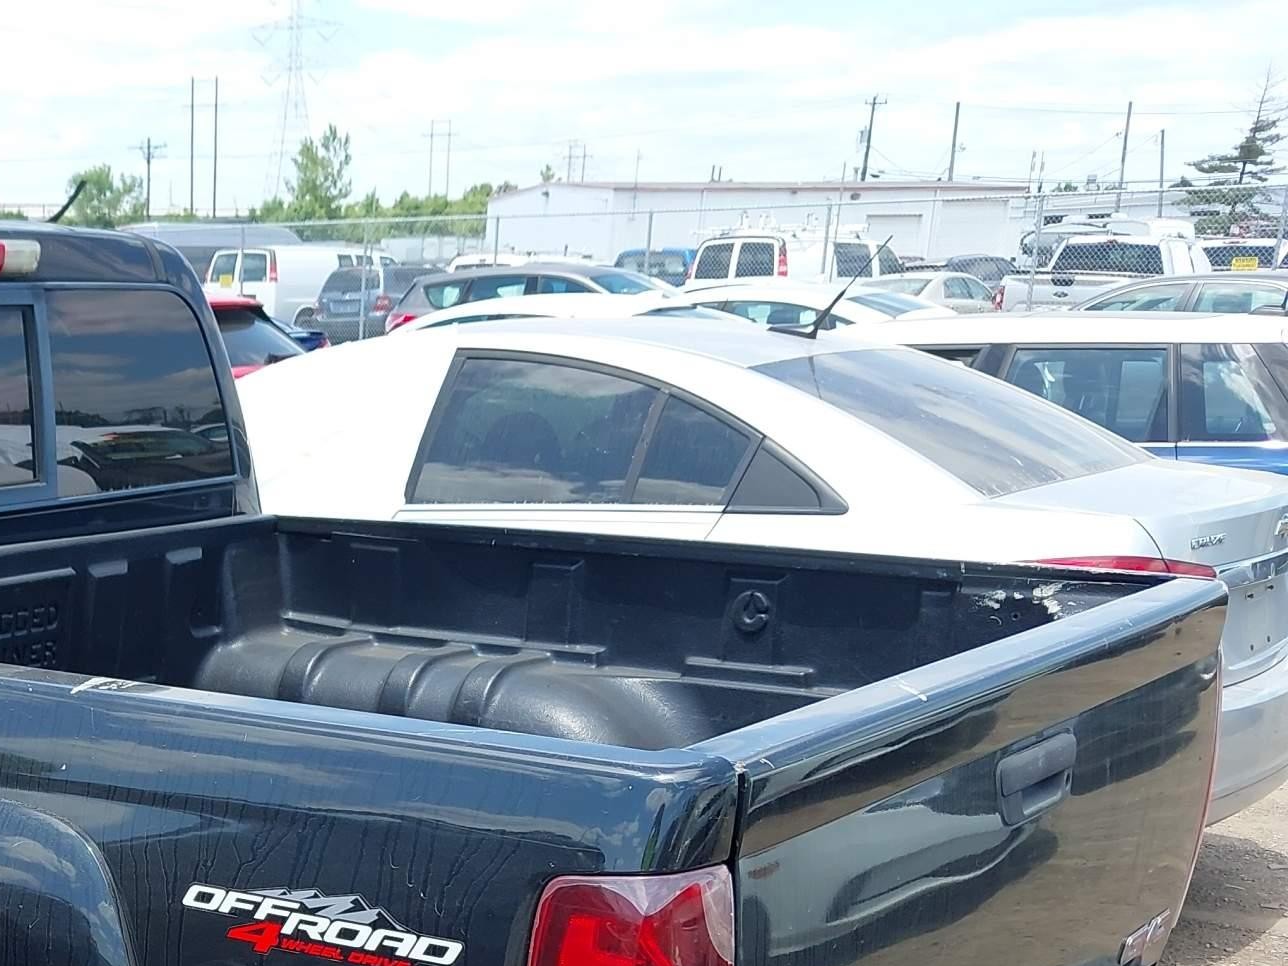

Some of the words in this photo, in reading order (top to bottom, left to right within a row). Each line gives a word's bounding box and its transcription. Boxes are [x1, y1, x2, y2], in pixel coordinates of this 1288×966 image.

[181, 884, 301, 920] OFF
[280, 910, 464, 966] ROAD
[225, 921, 283, 954] 4
[280, 938, 345, 960] WHEEL
